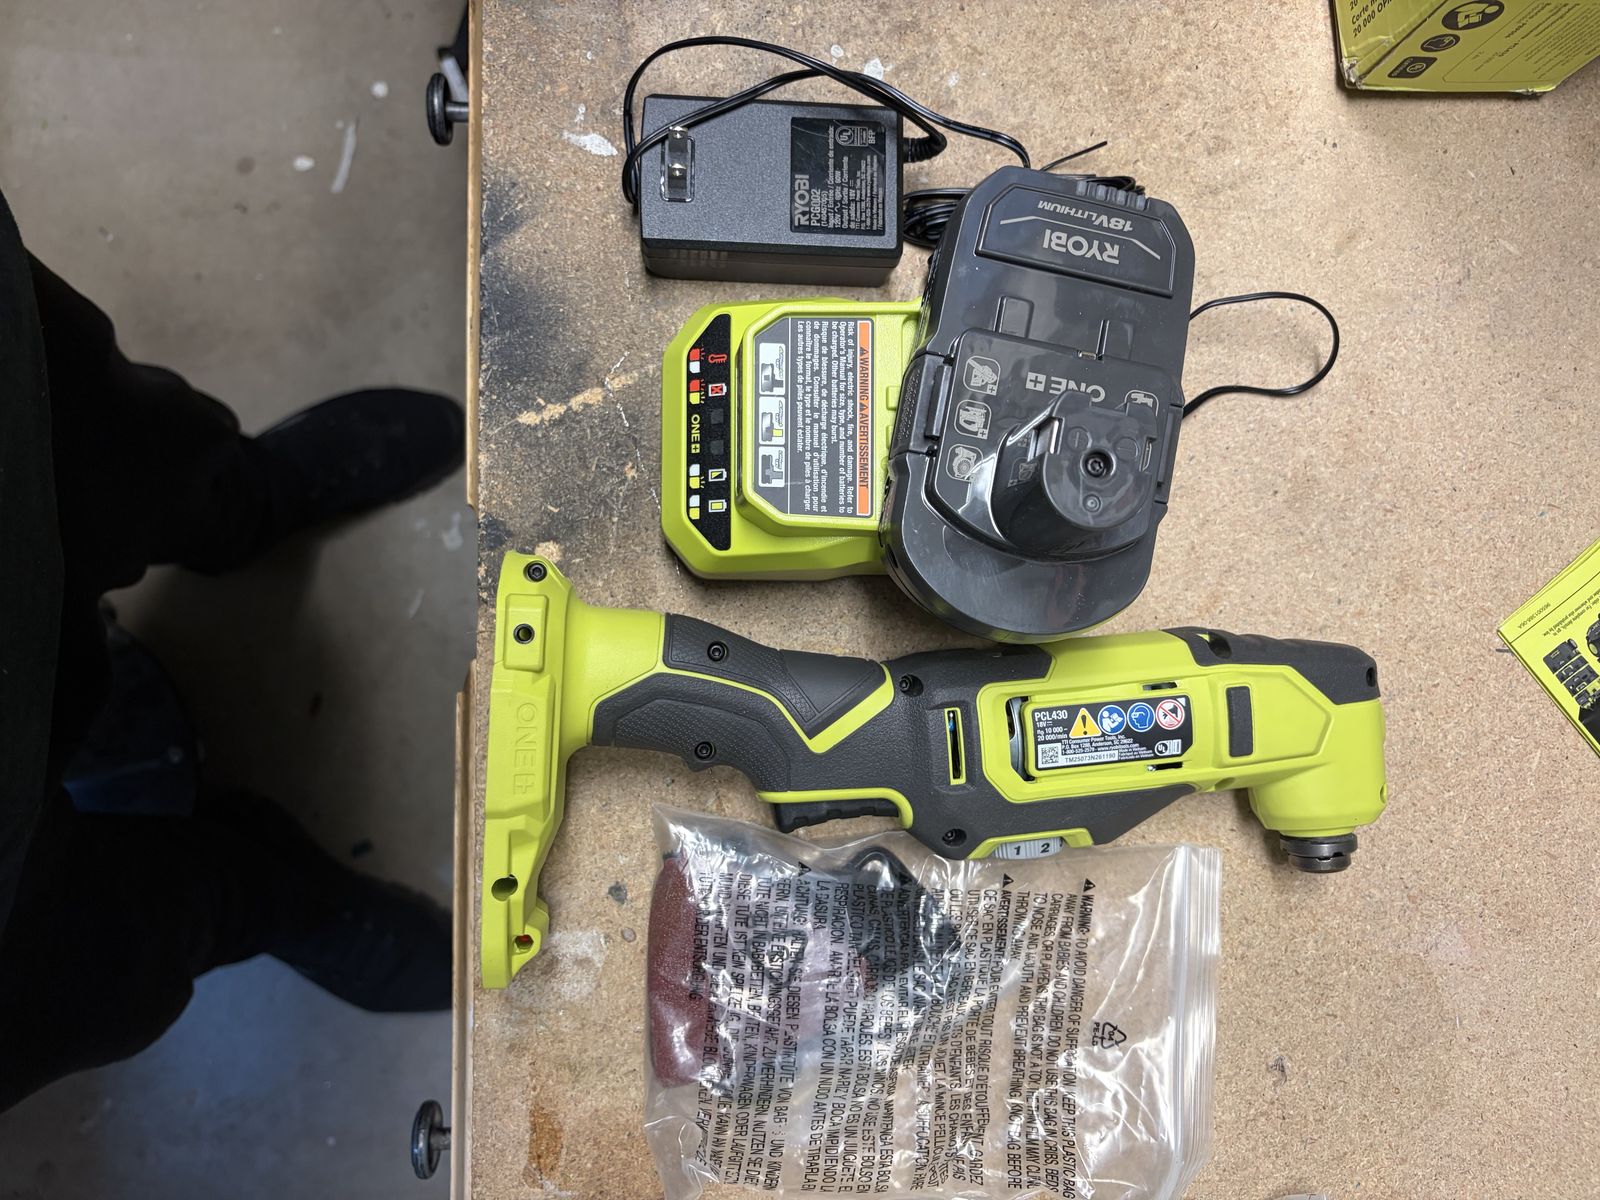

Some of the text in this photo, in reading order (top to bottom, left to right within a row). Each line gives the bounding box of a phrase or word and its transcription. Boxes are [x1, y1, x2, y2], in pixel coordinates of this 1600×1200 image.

[1353, 25, 1362, 37] 20
[1363, 10, 1376, 28] 000
[795, 175, 809, 226] RYOBI
[811, 189, 820, 226] PCG002
[1043, 229, 1120, 264] RYOBI
[859, 358, 868, 489] WARNING AVERTISSEMENT
[1034, 710, 1068, 721] PCL430
[1014, 843, 1050, 855] 1 2
[1034, 893, 1048, 904] TO
[1064, 894, 1077, 915] AWAY
[1031, 906, 1045, 930] NOSE
[1043, 893, 1063, 938] CARRIAGES,
[1060, 916, 1074, 939] FROM
[1027, 933, 1039, 949] AND
[1042, 940, 1054, 951] OR
[1056, 941, 1071, 970] BABIES
[1055, 972, 1067, 988] AND
[1019, 985, 1032, 1002] AND
[1033, 997, 1048, 1013] THIS
[1013, 1006, 1029, 1046] PREVENT
[1032, 1016, 1045, 1031] BAG
[1048, 1035, 1060, 1047] DO
[1062, 894, 1094, 1198] WARNING: TO AVOID DANGER OF KEEP THIS PLASTIC BAG
[1030, 1044, 1042, 1060] NOT
[1047, 1049, 1059, 1065] NOT
[1029, 1070, 1042, 1085] TOY.
[1046, 1069, 1058, 1085] USE
[1044, 1108, 1057, 1126] BAG
[1046, 1129, 1057, 1137] IN
[1026, 1147, 1039, 1163] MAY
[1043, 1140, 1058, 1166] CRIBS,
[1007, 1154, 1022, 1188] BEFORE
